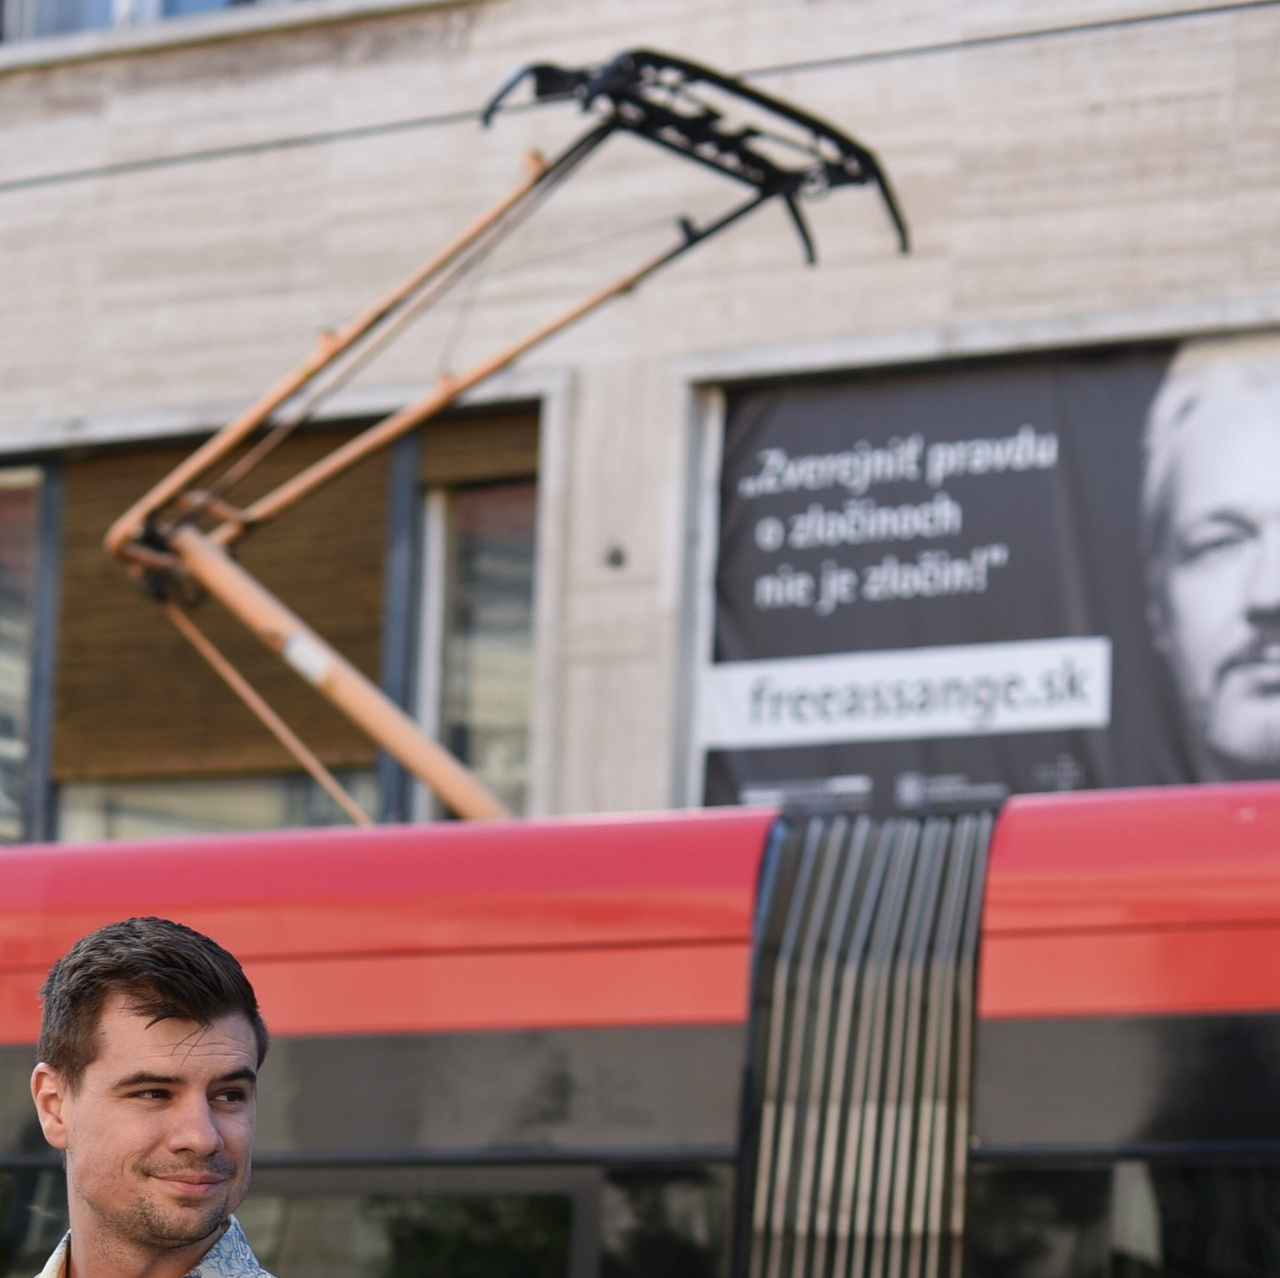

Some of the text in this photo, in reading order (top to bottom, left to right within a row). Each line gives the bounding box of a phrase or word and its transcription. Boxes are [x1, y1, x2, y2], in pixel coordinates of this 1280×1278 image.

[927, 425, 1058, 487] pravdu
[755, 517, 785, 550] o
[754, 564, 815, 609] nie
[817, 560, 856, 615] je
[749, 657, 1089, 728] freeassange.sk
